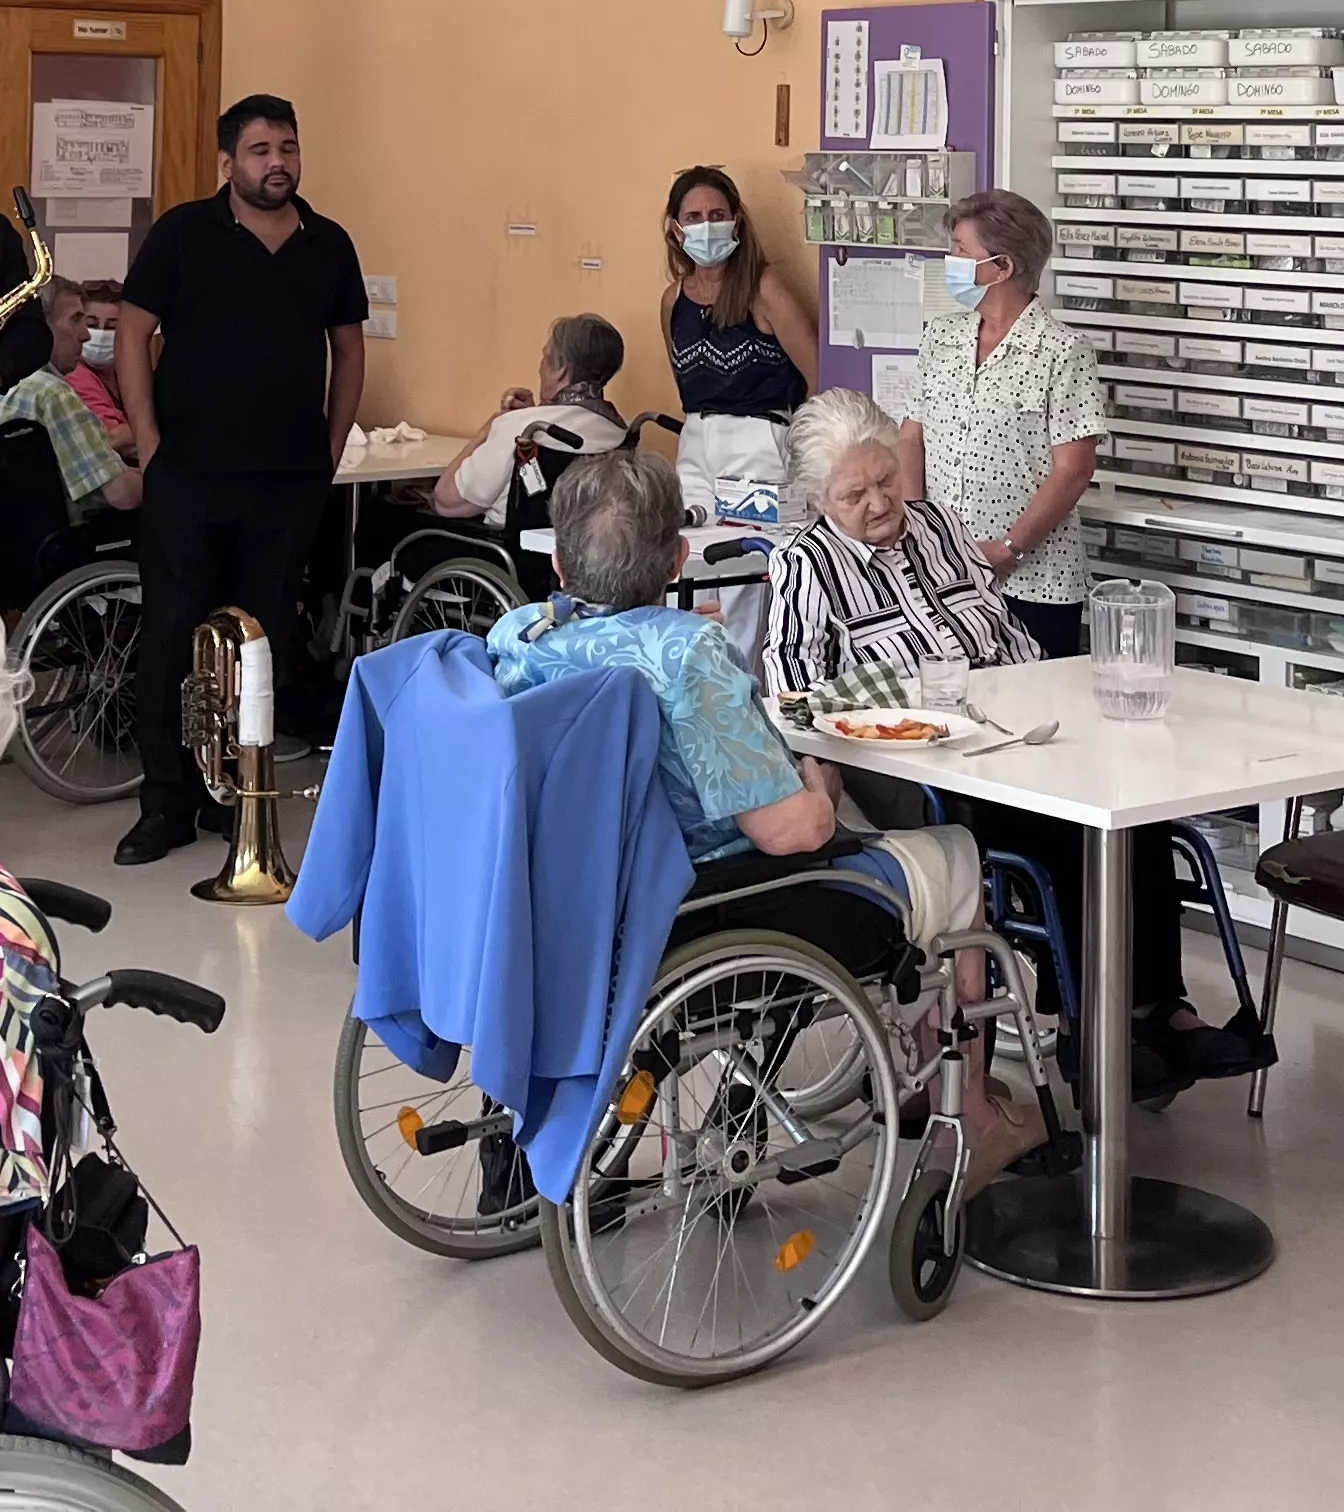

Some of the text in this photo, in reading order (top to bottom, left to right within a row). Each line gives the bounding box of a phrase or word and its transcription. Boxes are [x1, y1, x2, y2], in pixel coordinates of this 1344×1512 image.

[1065, 46, 1107, 59] SABADO
[1148, 42, 1197, 59] SABADO
[1245, 42, 1292, 57] SABADO
[1065, 83, 1101, 96] DOMINGO
[1152, 83, 1200, 99] DOMINGO
[1237, 83, 1284, 97] DOMINGO
